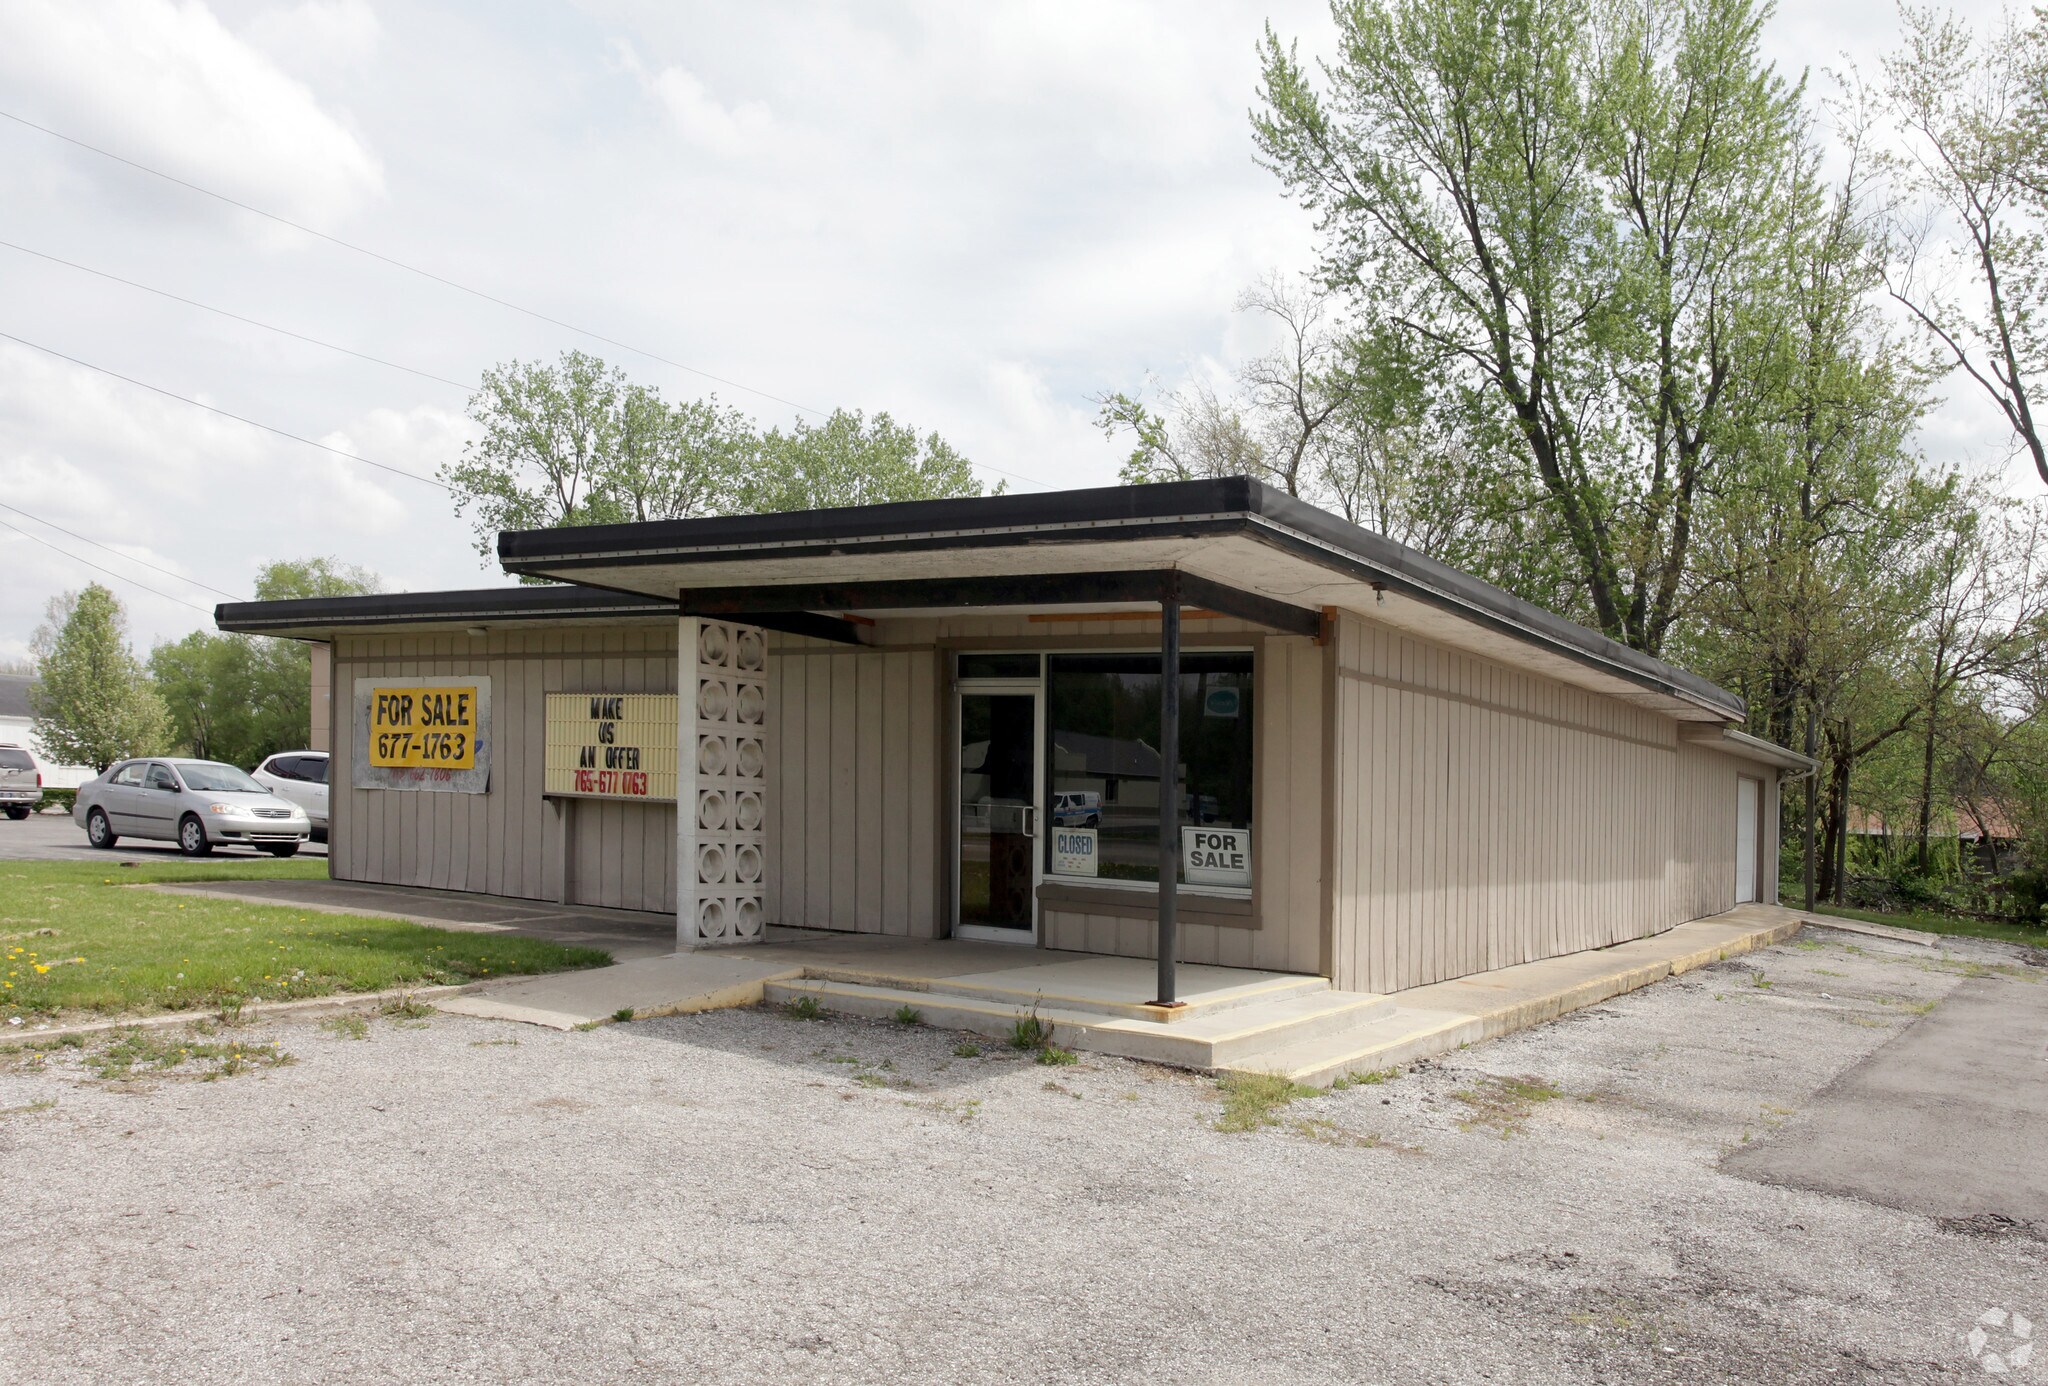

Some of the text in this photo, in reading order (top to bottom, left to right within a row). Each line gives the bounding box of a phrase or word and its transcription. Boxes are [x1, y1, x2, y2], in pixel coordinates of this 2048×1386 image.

[377, 693, 469, 726] FOR SALE
[590, 697, 623, 720] MAKE
[598, 722, 614, 744] US
[378, 732, 466, 760] 677-1763
[580, 746, 640, 770] AN OFFER
[1058, 834, 1093, 855] CLOSED
[1195, 833, 1237, 851] FOR
[1190, 850, 1245, 869] SALE
